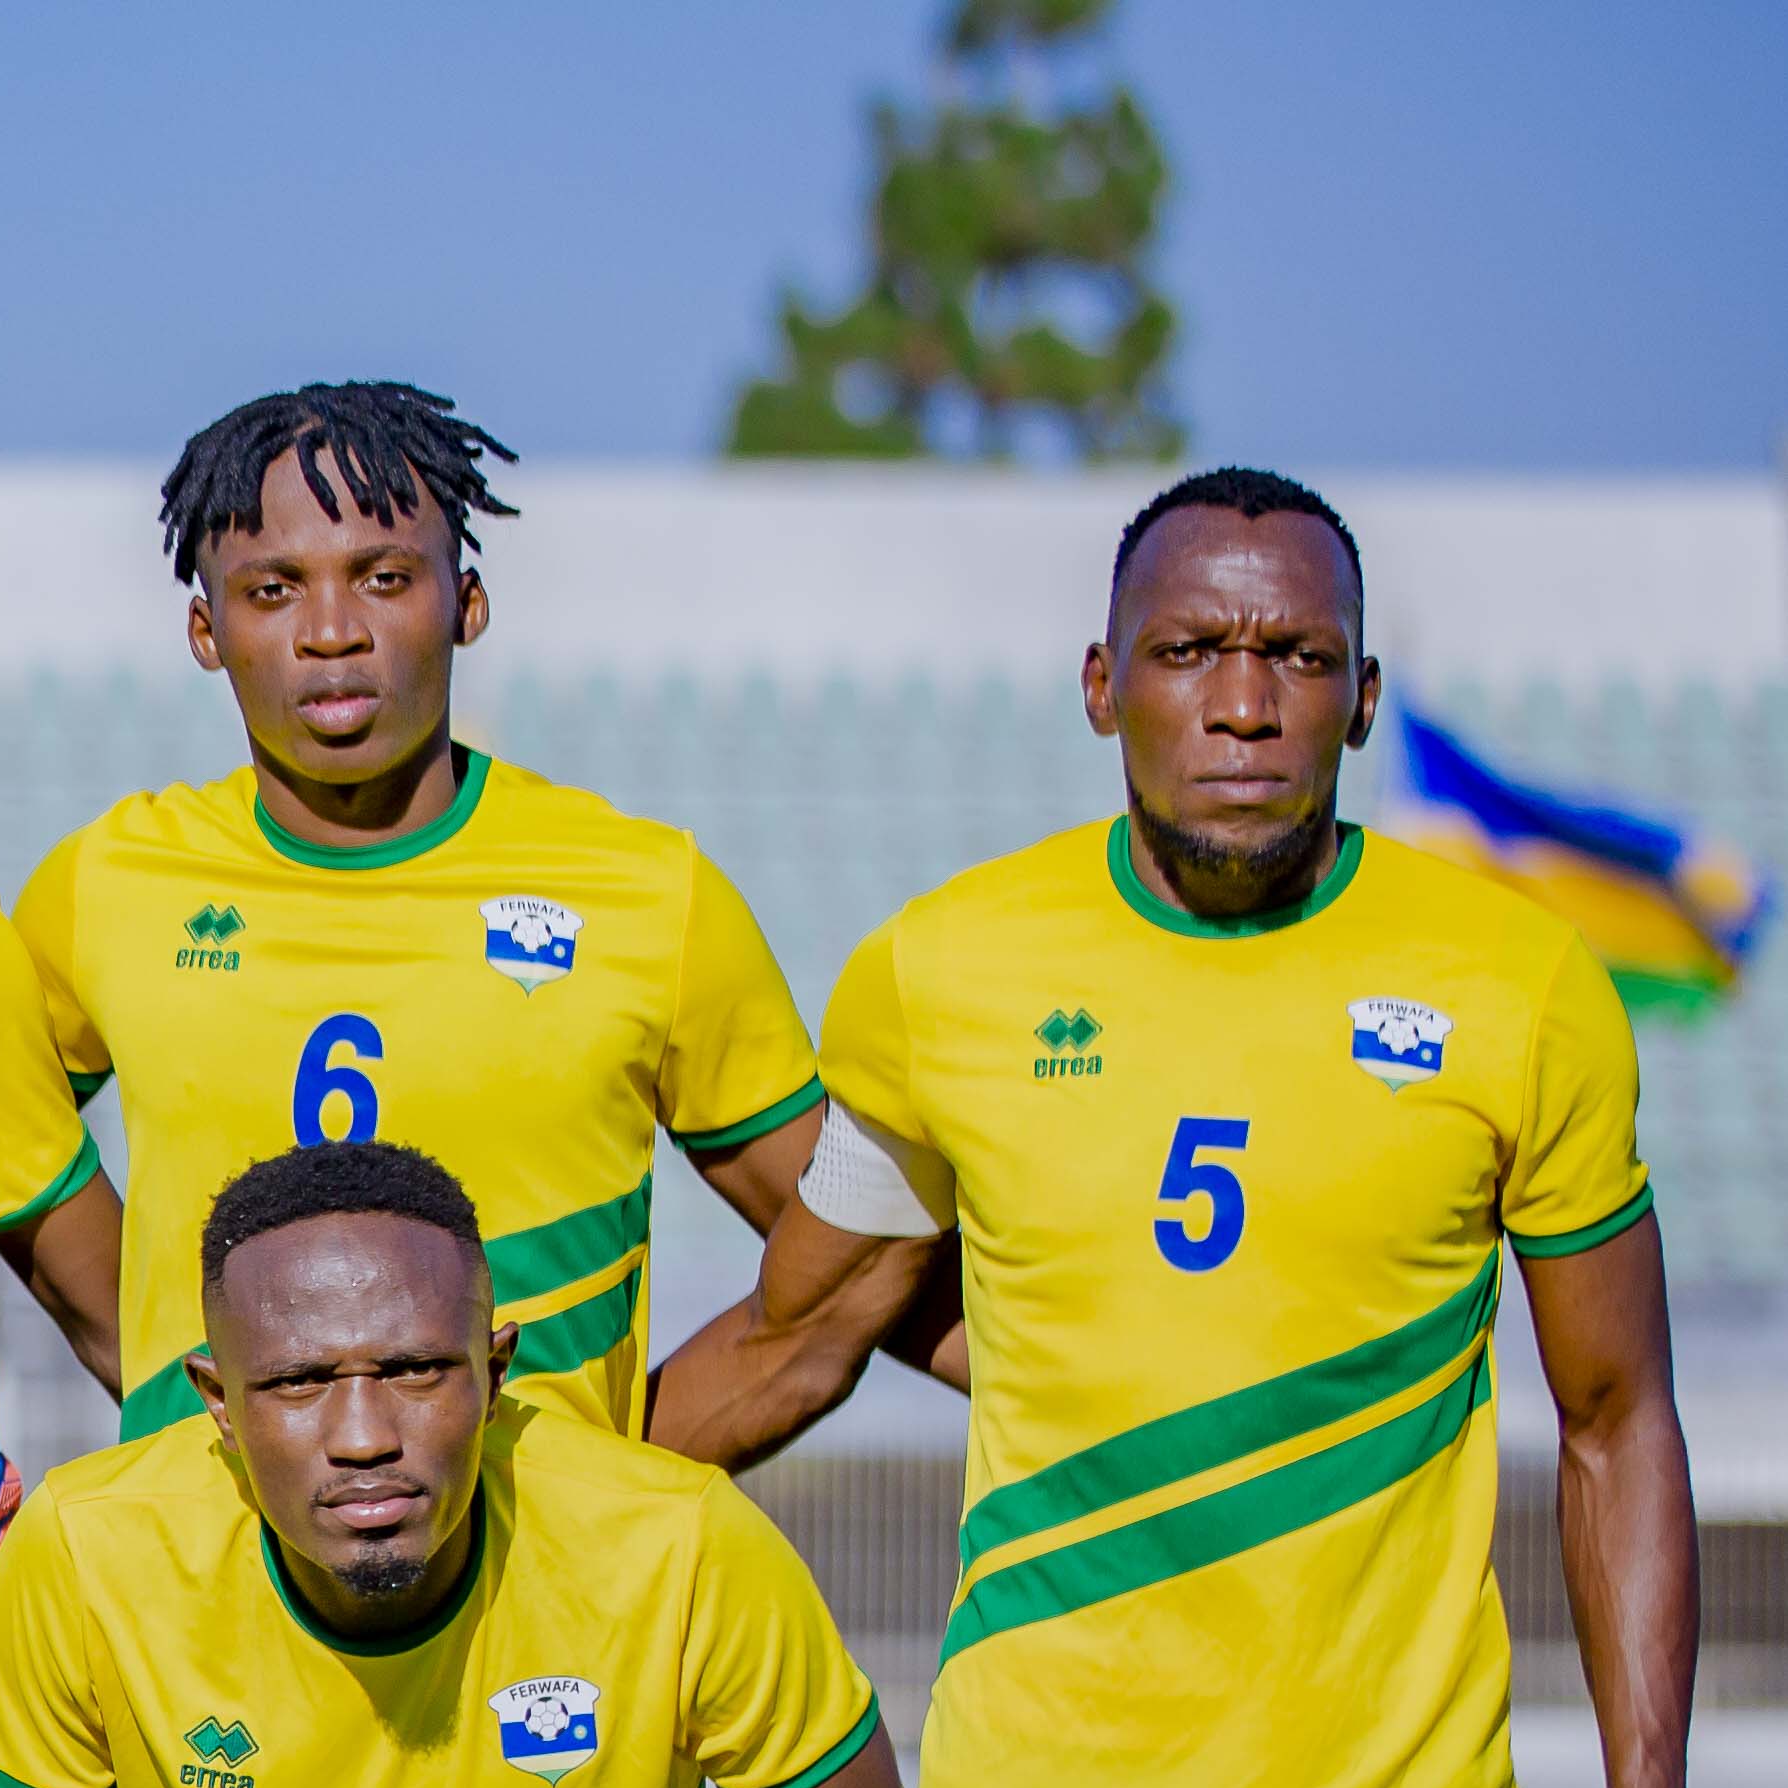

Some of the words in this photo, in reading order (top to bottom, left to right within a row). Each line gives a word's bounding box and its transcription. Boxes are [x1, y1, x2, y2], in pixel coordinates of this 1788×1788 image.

[175, 947, 241, 972] errea
[292, 1010, 384, 1149] 6
[1033, 1054, 1103, 1080] errea
[1153, 1115, 1251, 1274] 5
[509, 1680, 582, 1703] FERWAFA
